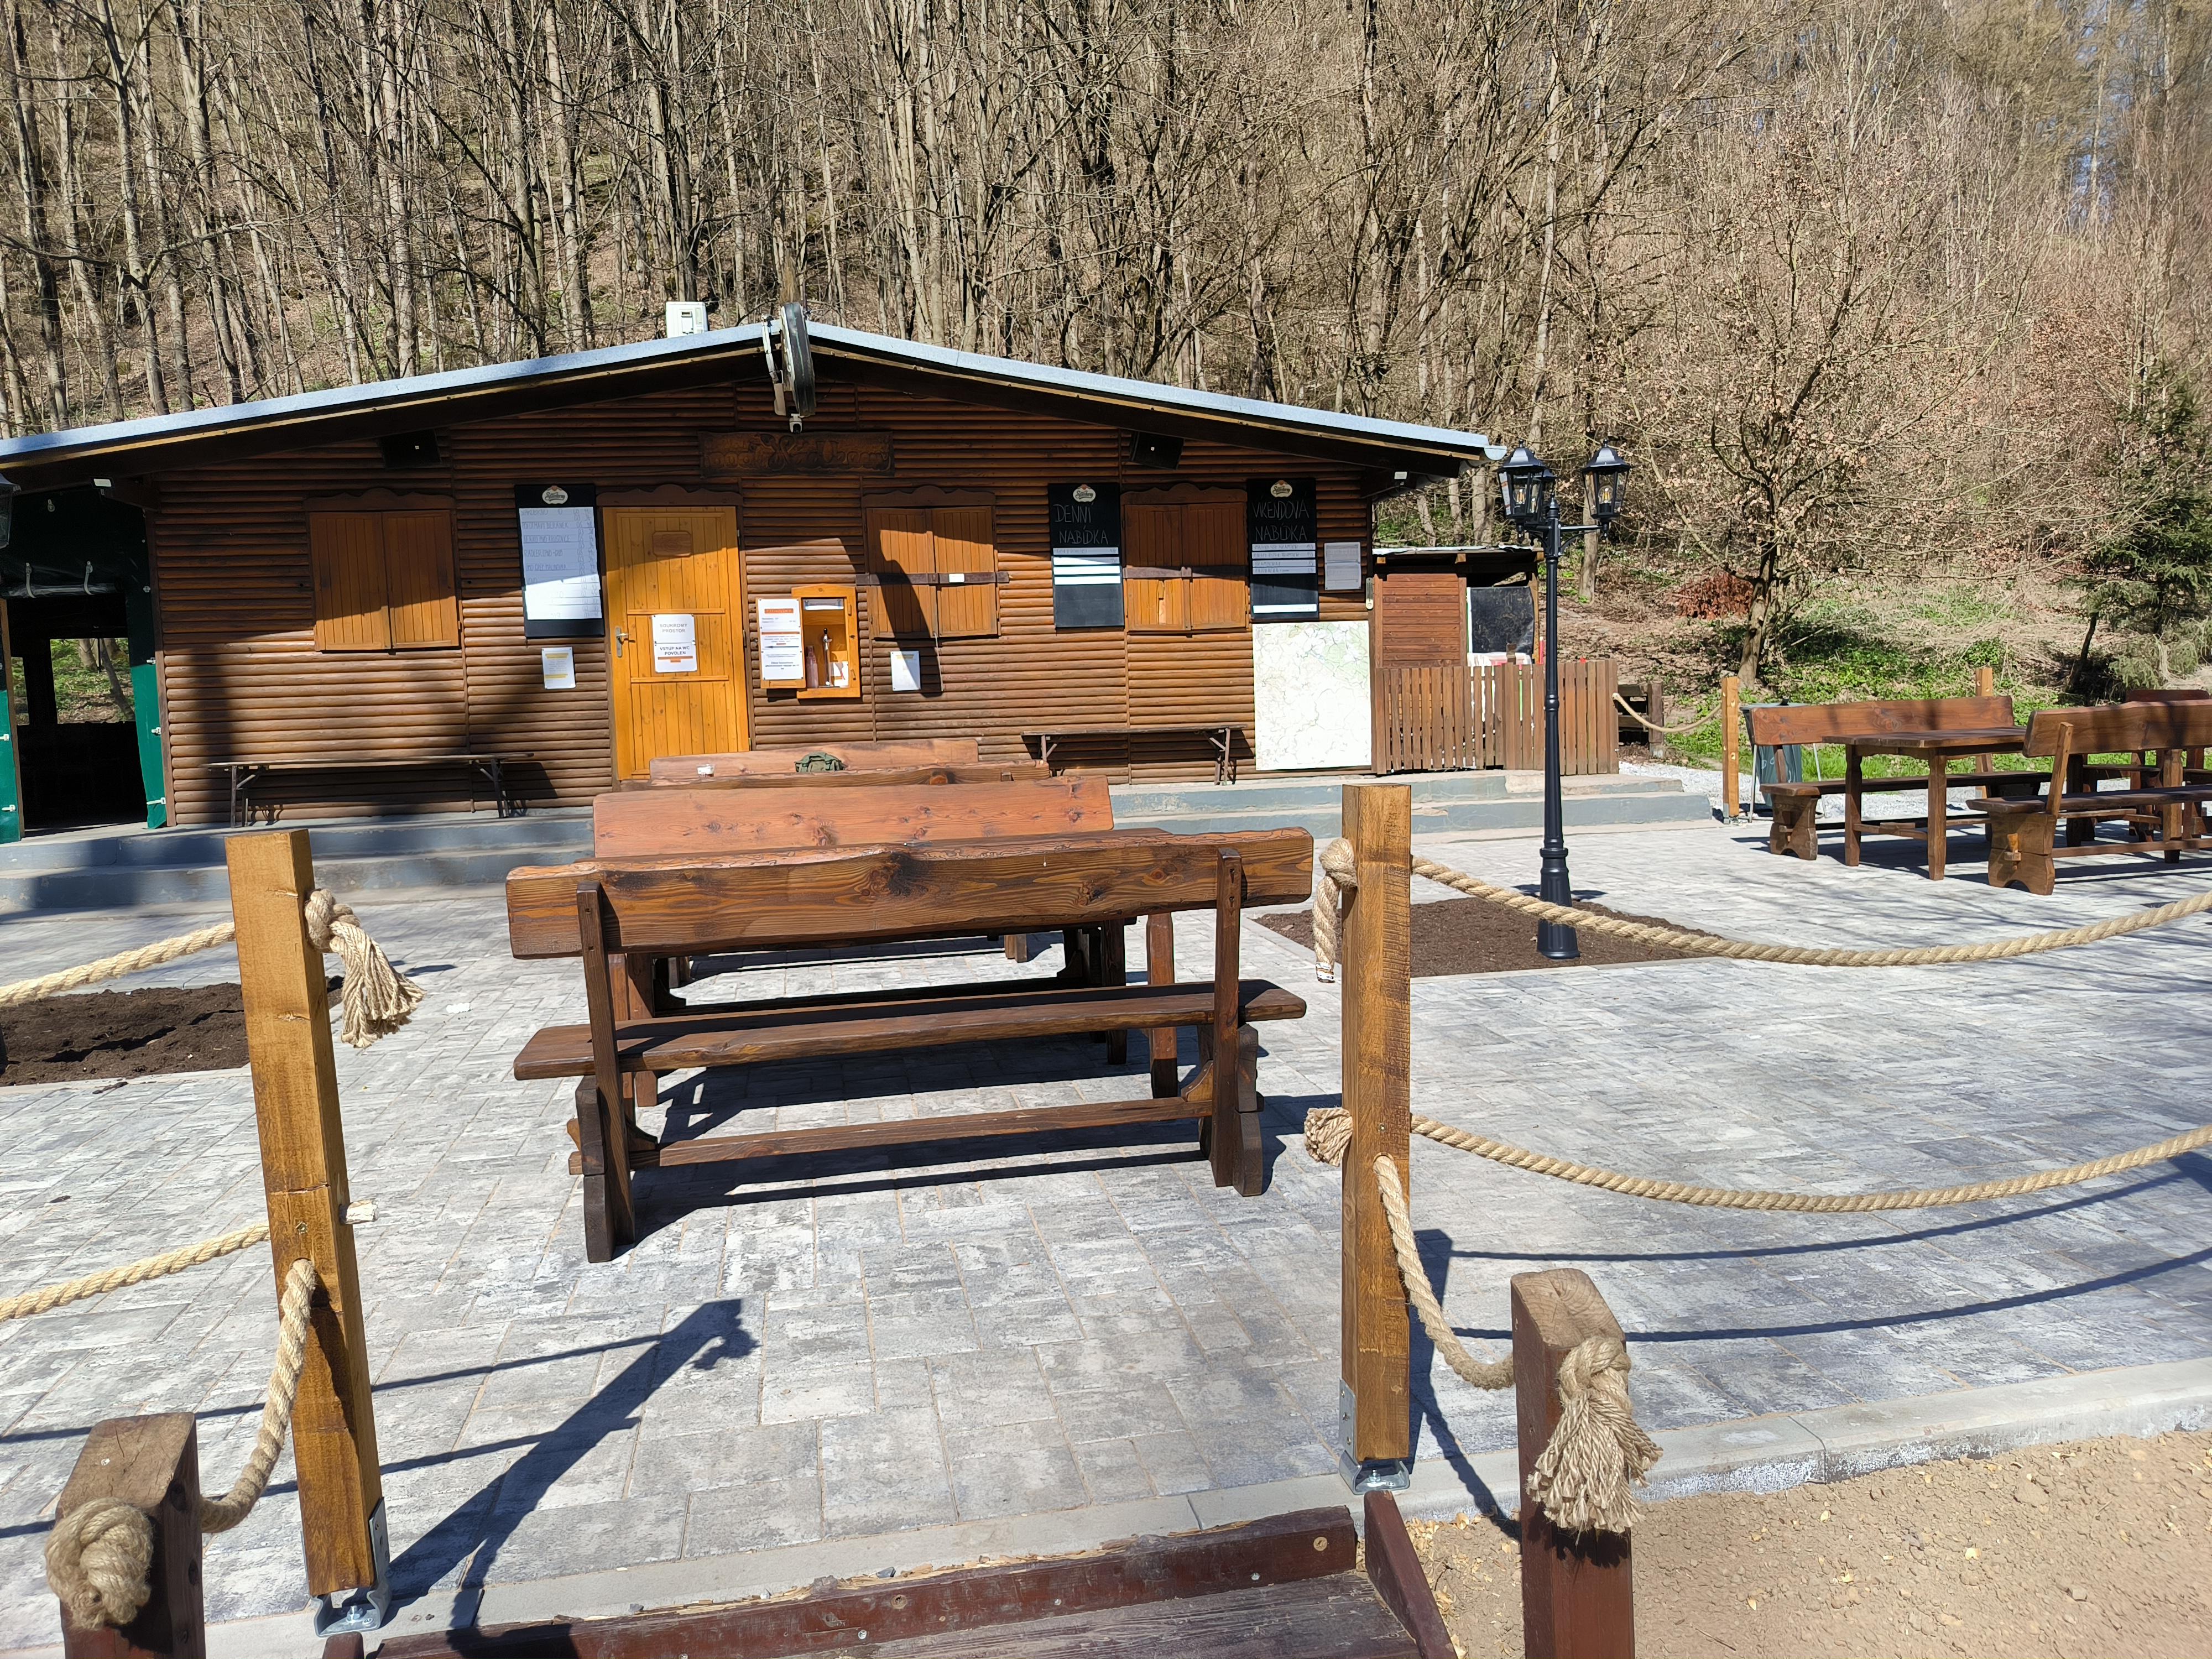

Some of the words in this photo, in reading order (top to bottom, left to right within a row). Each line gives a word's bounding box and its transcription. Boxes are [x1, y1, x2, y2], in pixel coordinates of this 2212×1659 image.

[1052, 502, 1094, 523] DENNÍ
[1059, 525, 1109, 545] NABÍDKA
[1255, 523, 1307, 542] NABÍDKA
